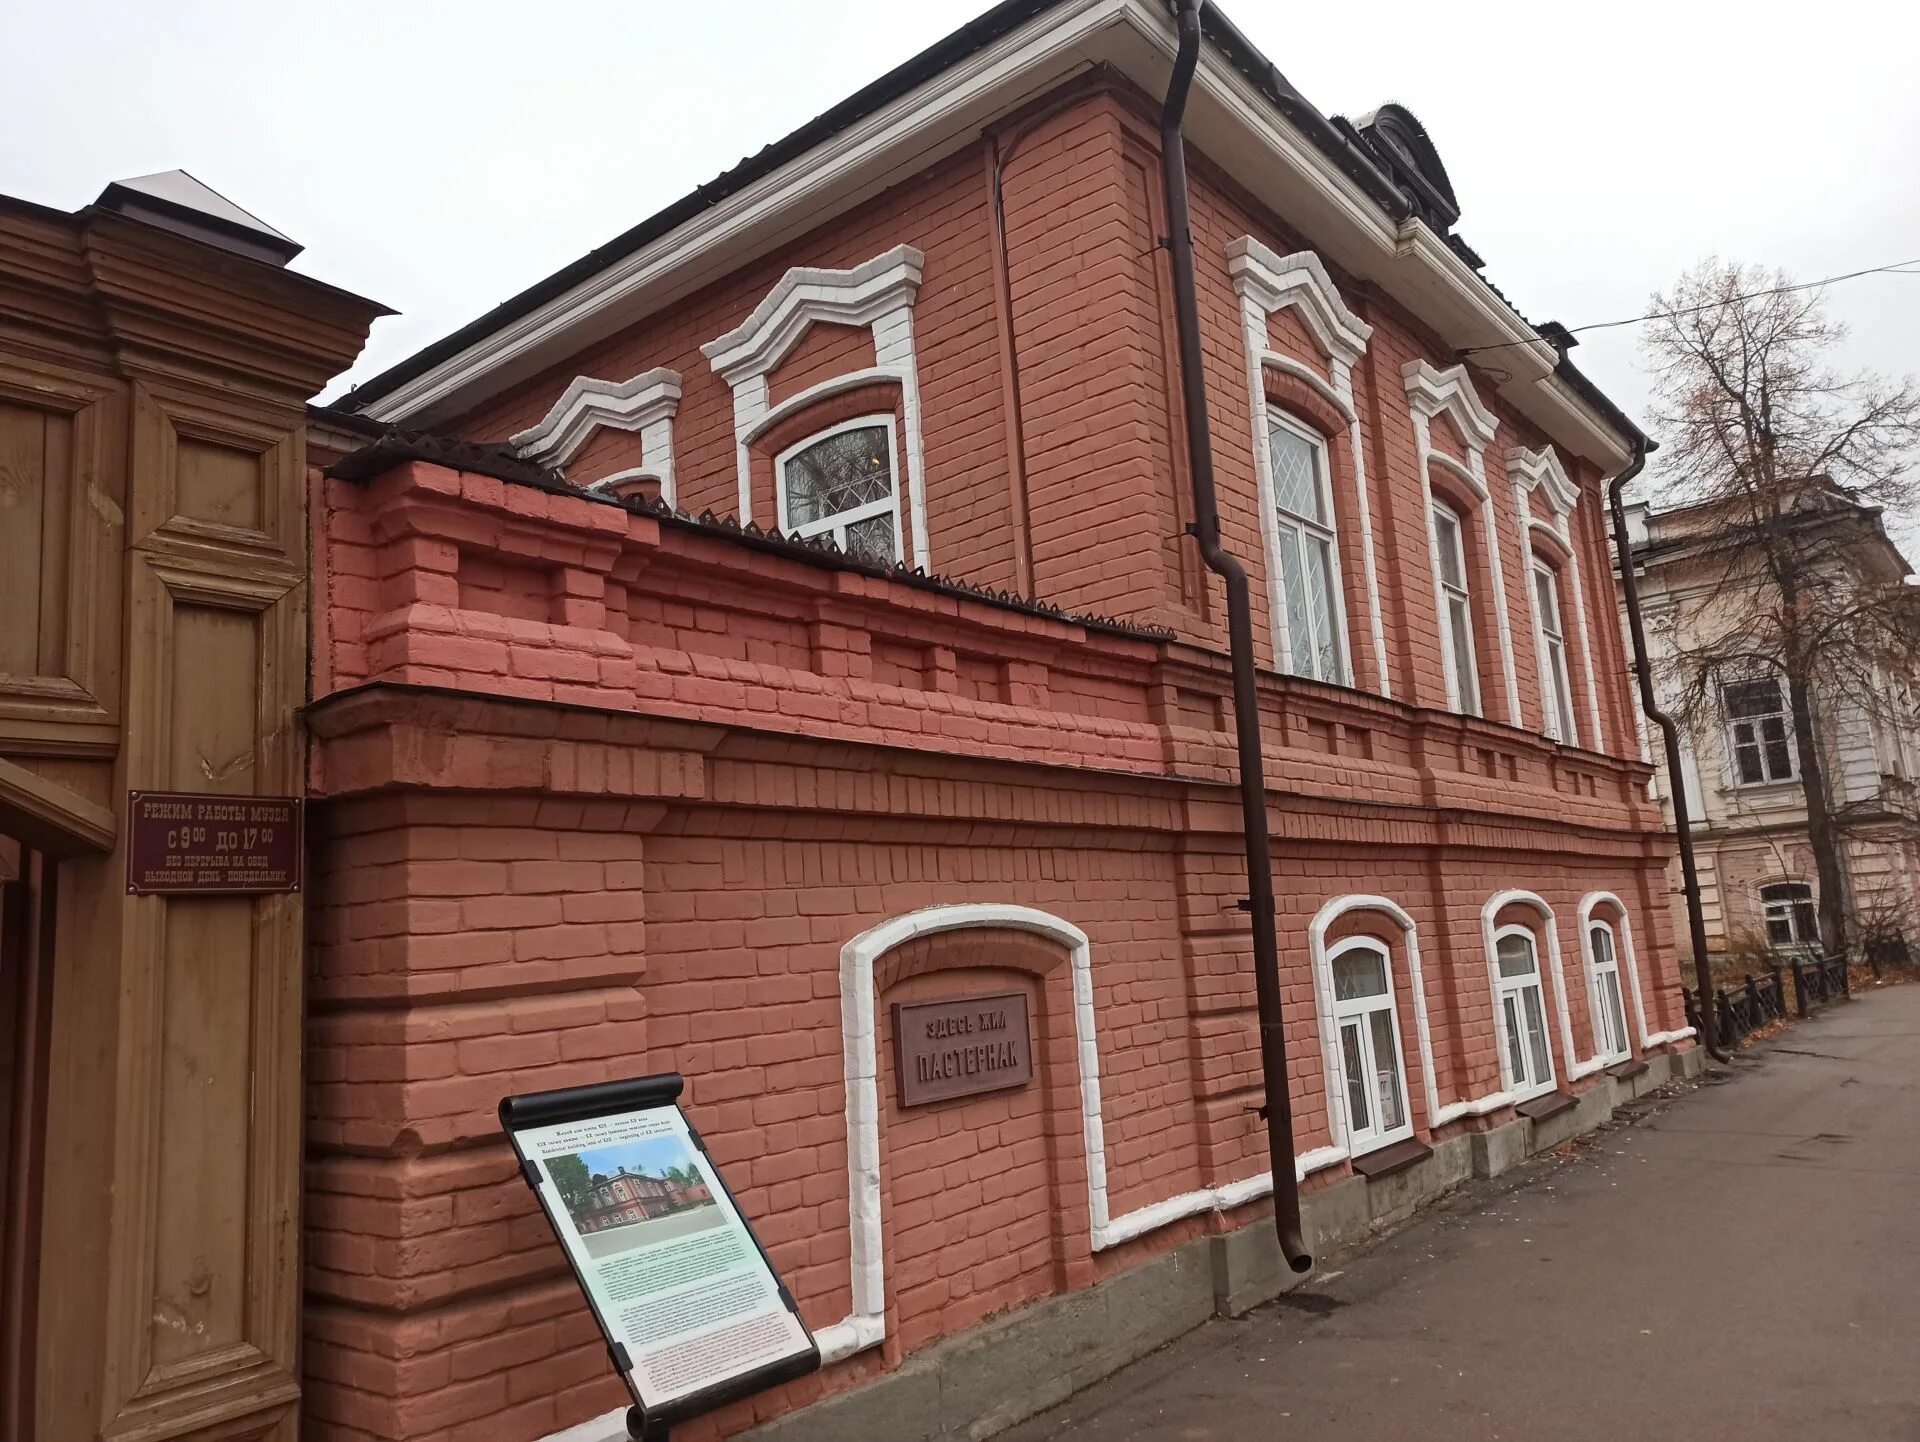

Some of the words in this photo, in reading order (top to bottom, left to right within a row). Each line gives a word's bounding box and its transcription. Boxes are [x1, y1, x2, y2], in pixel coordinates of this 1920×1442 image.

[144, 803, 192, 819] РЕЖИМ
[198, 805, 245, 821] РАБОТЫ
[251, 806, 289, 822] МУЗЕЯ
[216, 832, 237, 851] ДО
[166, 855, 182, 867] БЕЗ
[184, 856, 229, 867] ПЕРЕРЫВА
[232, 856, 244, 867] НА
[248, 856, 269, 868] ОБЕД
[145, 871, 194, 883] ВЫХОДНОЙ
[198, 871, 221, 884] ДЕНЬ
[227, 871, 286, 883] ПОНЕДЕЛЬНИК
[926, 1015, 973, 1039] ЗДЕСЬ
[979, 1011, 1006, 1032] ЖИЛ
[917, 1040, 1018, 1083] ПАСТЕРНАК
